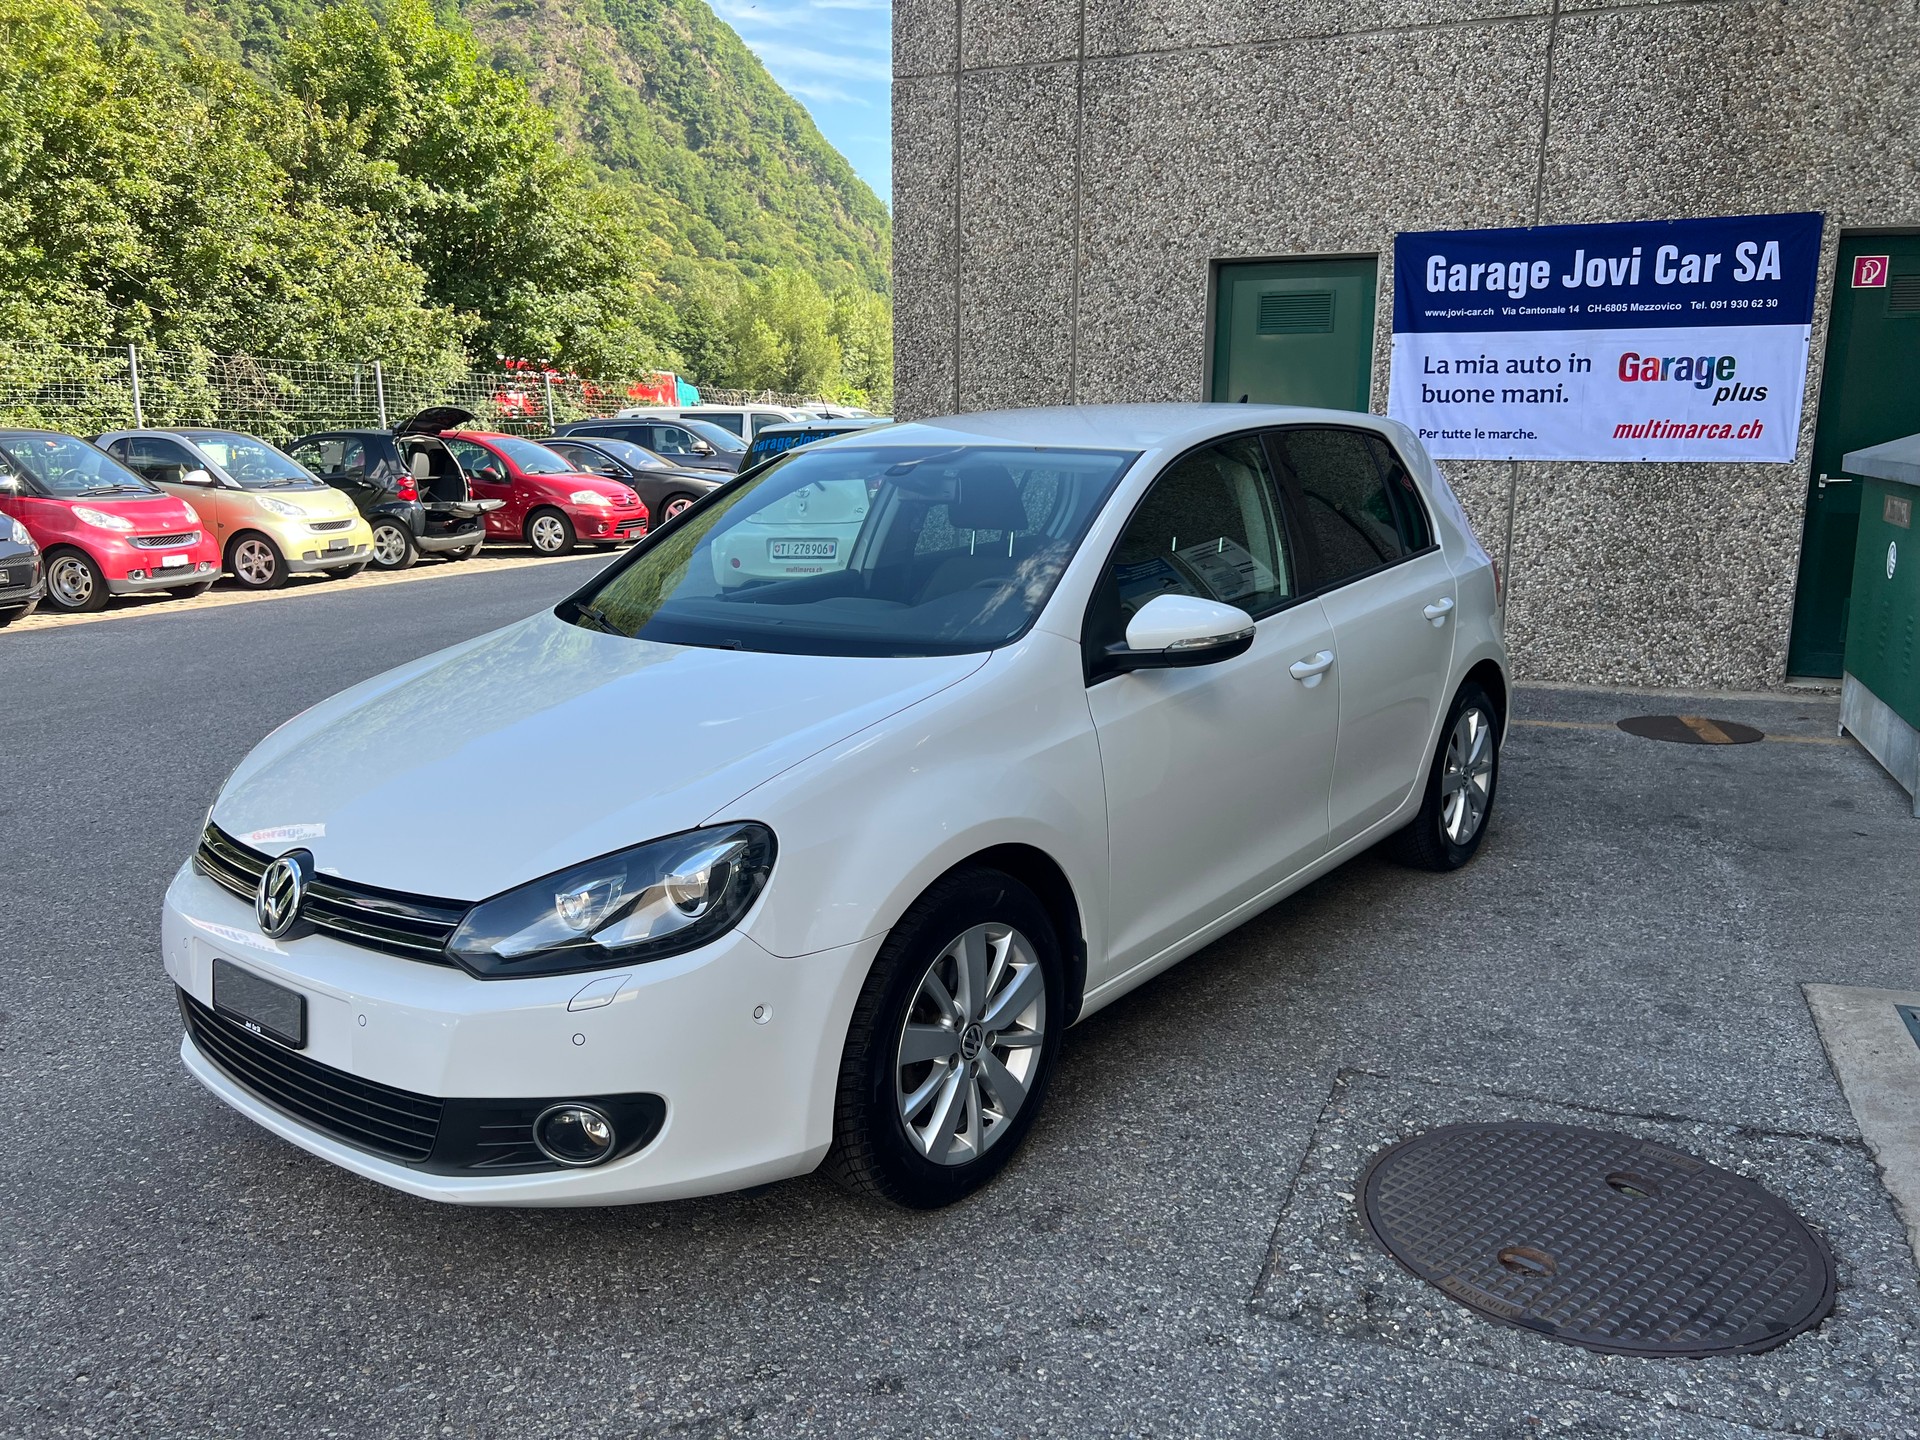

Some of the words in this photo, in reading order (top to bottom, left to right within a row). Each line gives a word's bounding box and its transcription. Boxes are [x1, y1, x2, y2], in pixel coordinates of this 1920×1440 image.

[1426, 254, 1551, 299] Garage
[1562, 247, 1642, 289] Jovi
[1655, 244, 1721, 285] Car
[1733, 241, 1781, 282] SA
[1424, 308, 1494, 318] www.jovi-car.ch
[1502, 307, 1516, 315] Via
[1518, 306, 1566, 314] Cantonale
[1569, 305, 1579, 313] 14
[1587, 303, 1628, 313] CH-6805
[1630, 302, 1682, 311] Mezzovico
[1691, 301, 1707, 310] Tel.
[1710, 300, 1727, 309] 091
[1730, 300, 1749, 308] 930
[1751, 299, 1763, 308] 62
[1766, 299, 1778, 307] 30
[1424, 355, 1449, 374] La
[1455, 354, 1499, 374] mia
[1506, 355, 1561, 374] auto
[1568, 353, 1592, 373] in
[1618, 352, 1736, 390] Garage
[1421, 383, 1495, 403] buone
[1501, 383, 1569, 403] mani.
[1712, 382, 1768, 406] plus
[1419, 428, 1438, 439] Per
[1442, 429, 1471, 439] tutte
[1474, 428, 1485, 439] le
[1488, 429, 1538, 439] marche.
[1612, 419, 1764, 439] multimarca.ch
[752, 436, 792, 452] Garage
